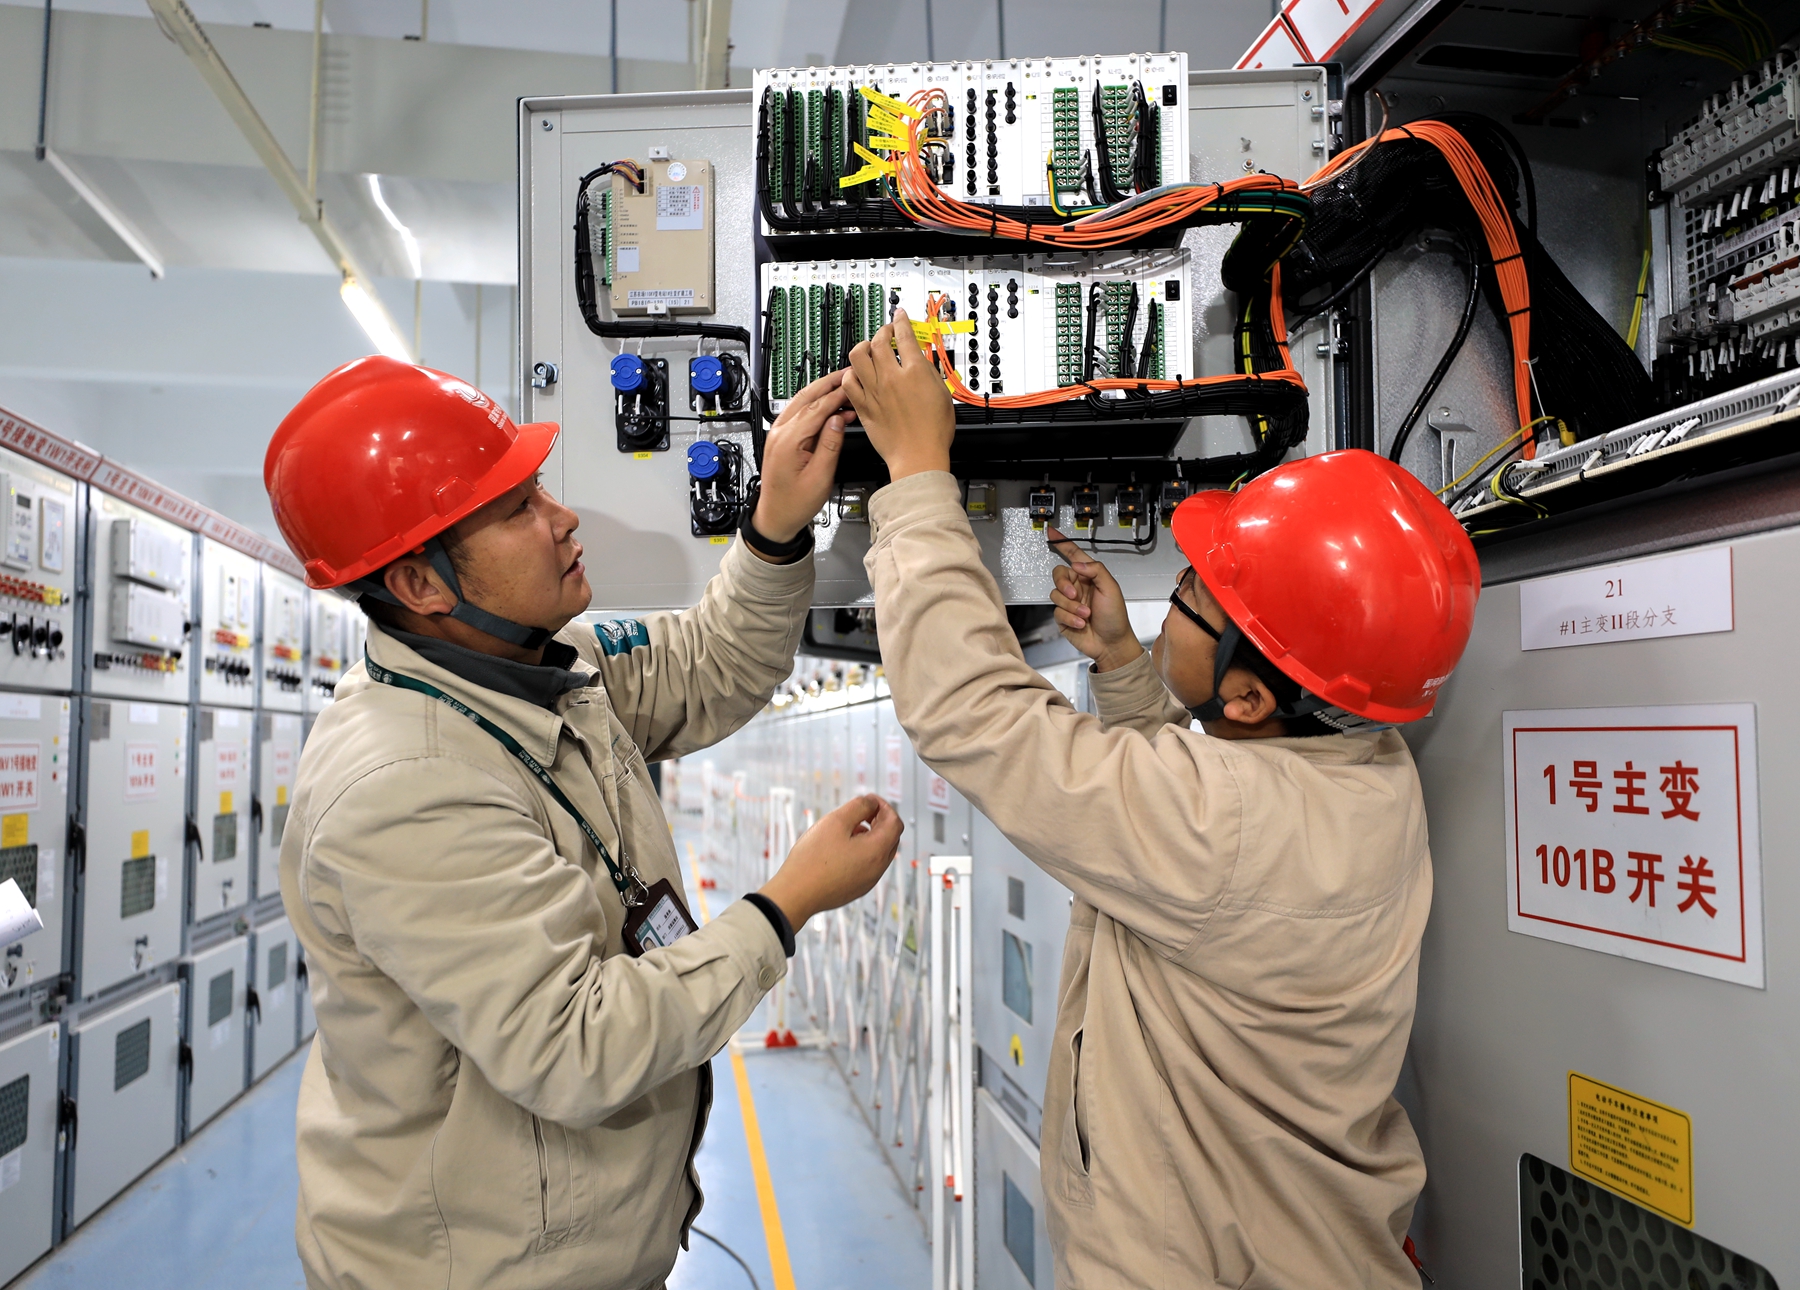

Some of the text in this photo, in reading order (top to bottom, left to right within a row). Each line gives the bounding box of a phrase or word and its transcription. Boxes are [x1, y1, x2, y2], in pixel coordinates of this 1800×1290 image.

[1604, 578, 1624, 599] 21
[1542, 759, 1701, 821] 1号主变
[1535, 844, 1718, 919] 101B开关
